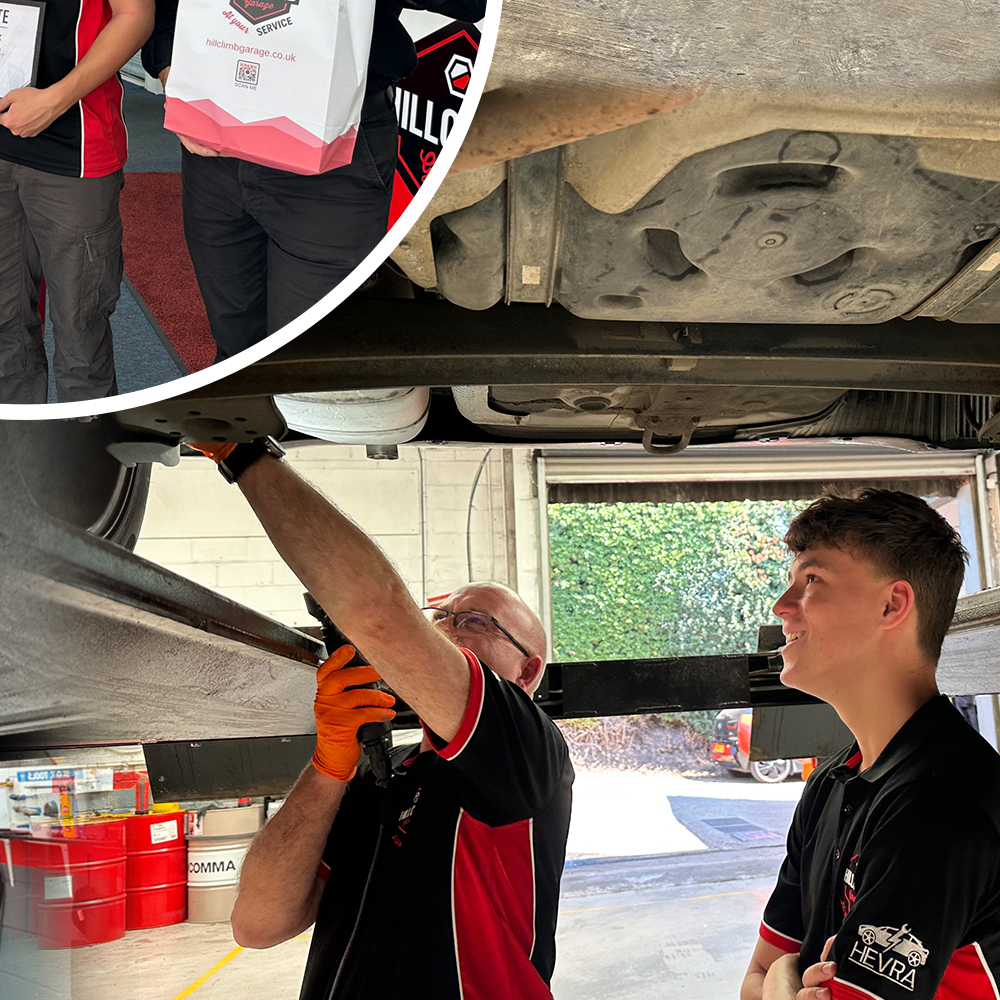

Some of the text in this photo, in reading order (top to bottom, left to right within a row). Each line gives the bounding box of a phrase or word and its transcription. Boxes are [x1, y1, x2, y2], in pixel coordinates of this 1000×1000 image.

[222, 10, 249, 34] At your
[256, 17, 293, 36] SERVICE
[206, 38, 296, 62] hillclimbgarage.co.uk
[850, 941, 916, 988] HEVRA
